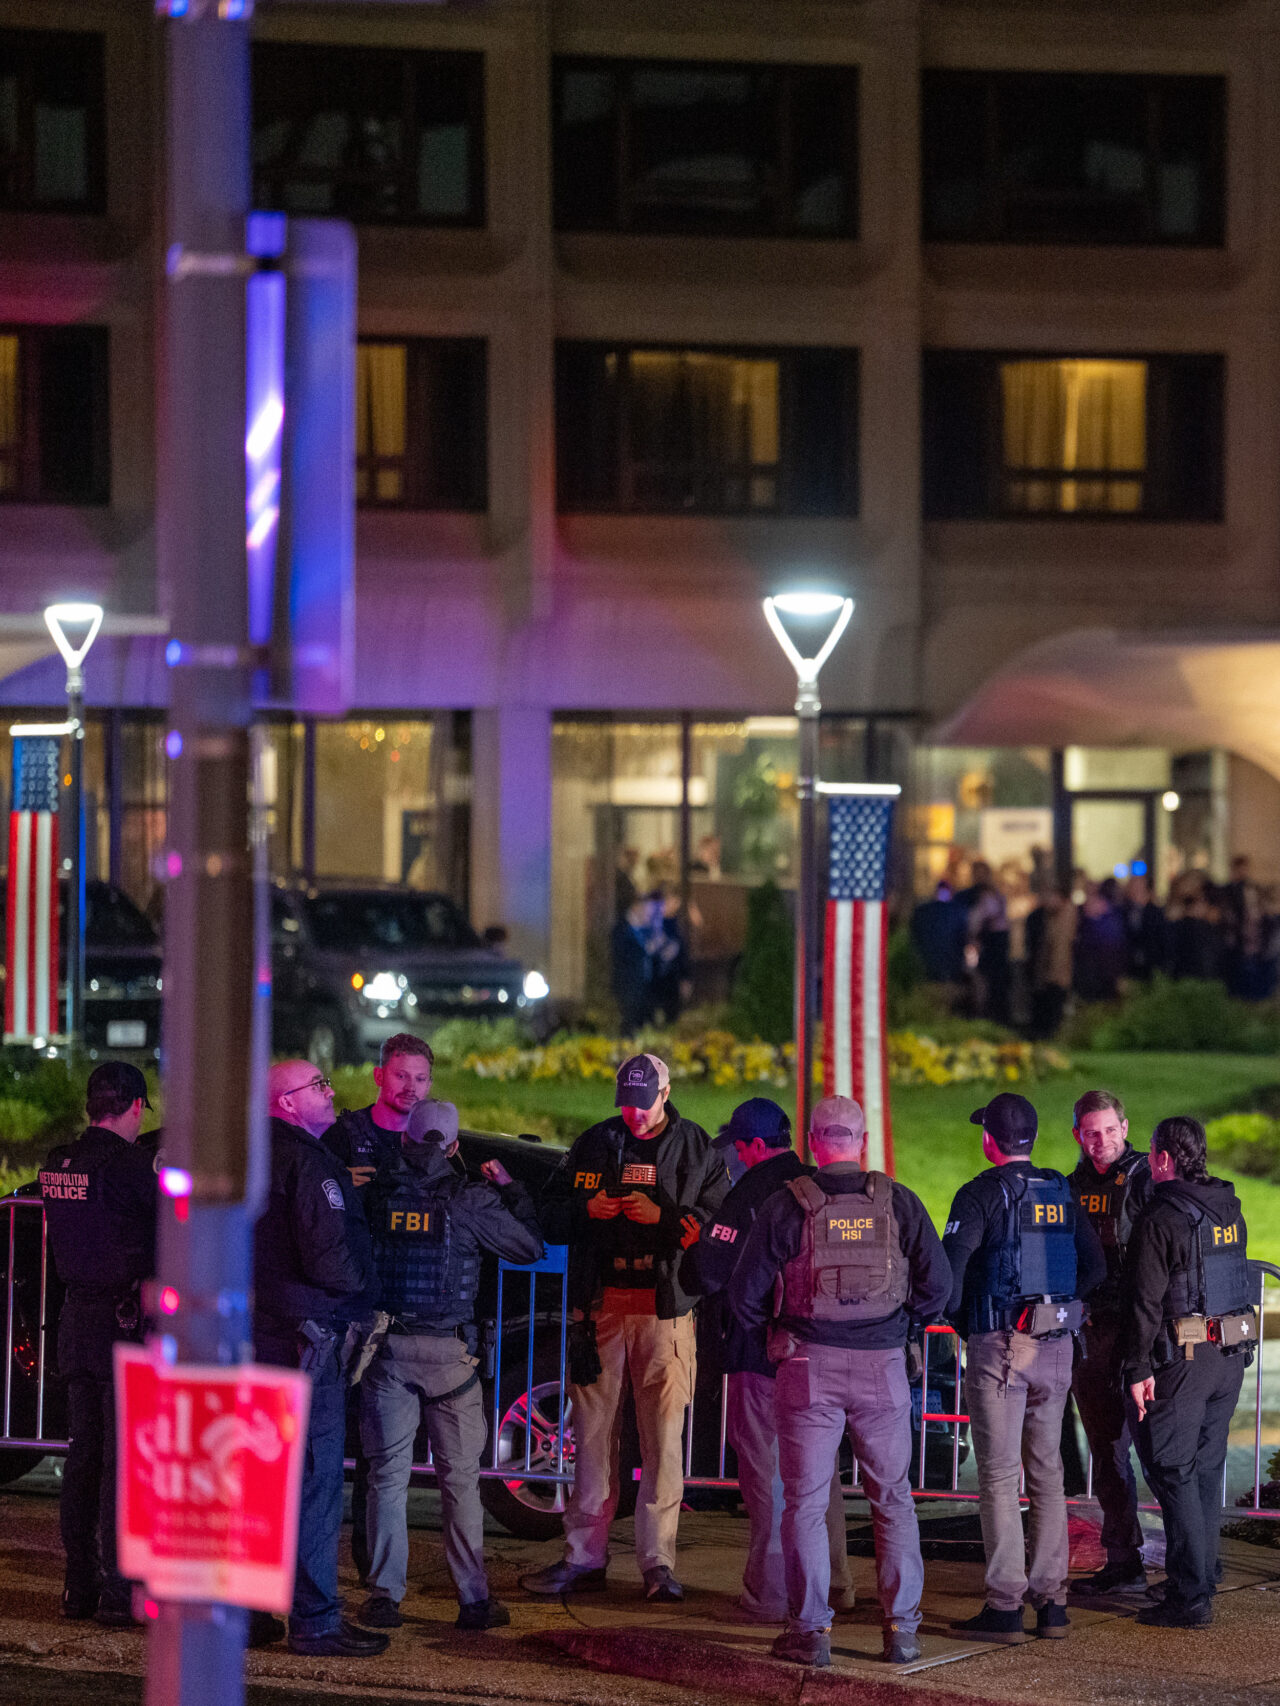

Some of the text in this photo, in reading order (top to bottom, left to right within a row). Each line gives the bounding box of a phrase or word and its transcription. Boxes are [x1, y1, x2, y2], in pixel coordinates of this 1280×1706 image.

[39, 1171, 89, 1187] METROPOLITAN
[574, 1172, 602, 1189] FBI
[42, 1185, 88, 1200] POLICE
[391, 1211, 430, 1232] FBI
[1034, 1204, 1064, 1223] FBI
[829, 1218, 873, 1230] POLICE
[711, 1223, 738, 1243] FBI
[842, 1230, 862, 1240] HSI
[1213, 1223, 1238, 1245] FBI
